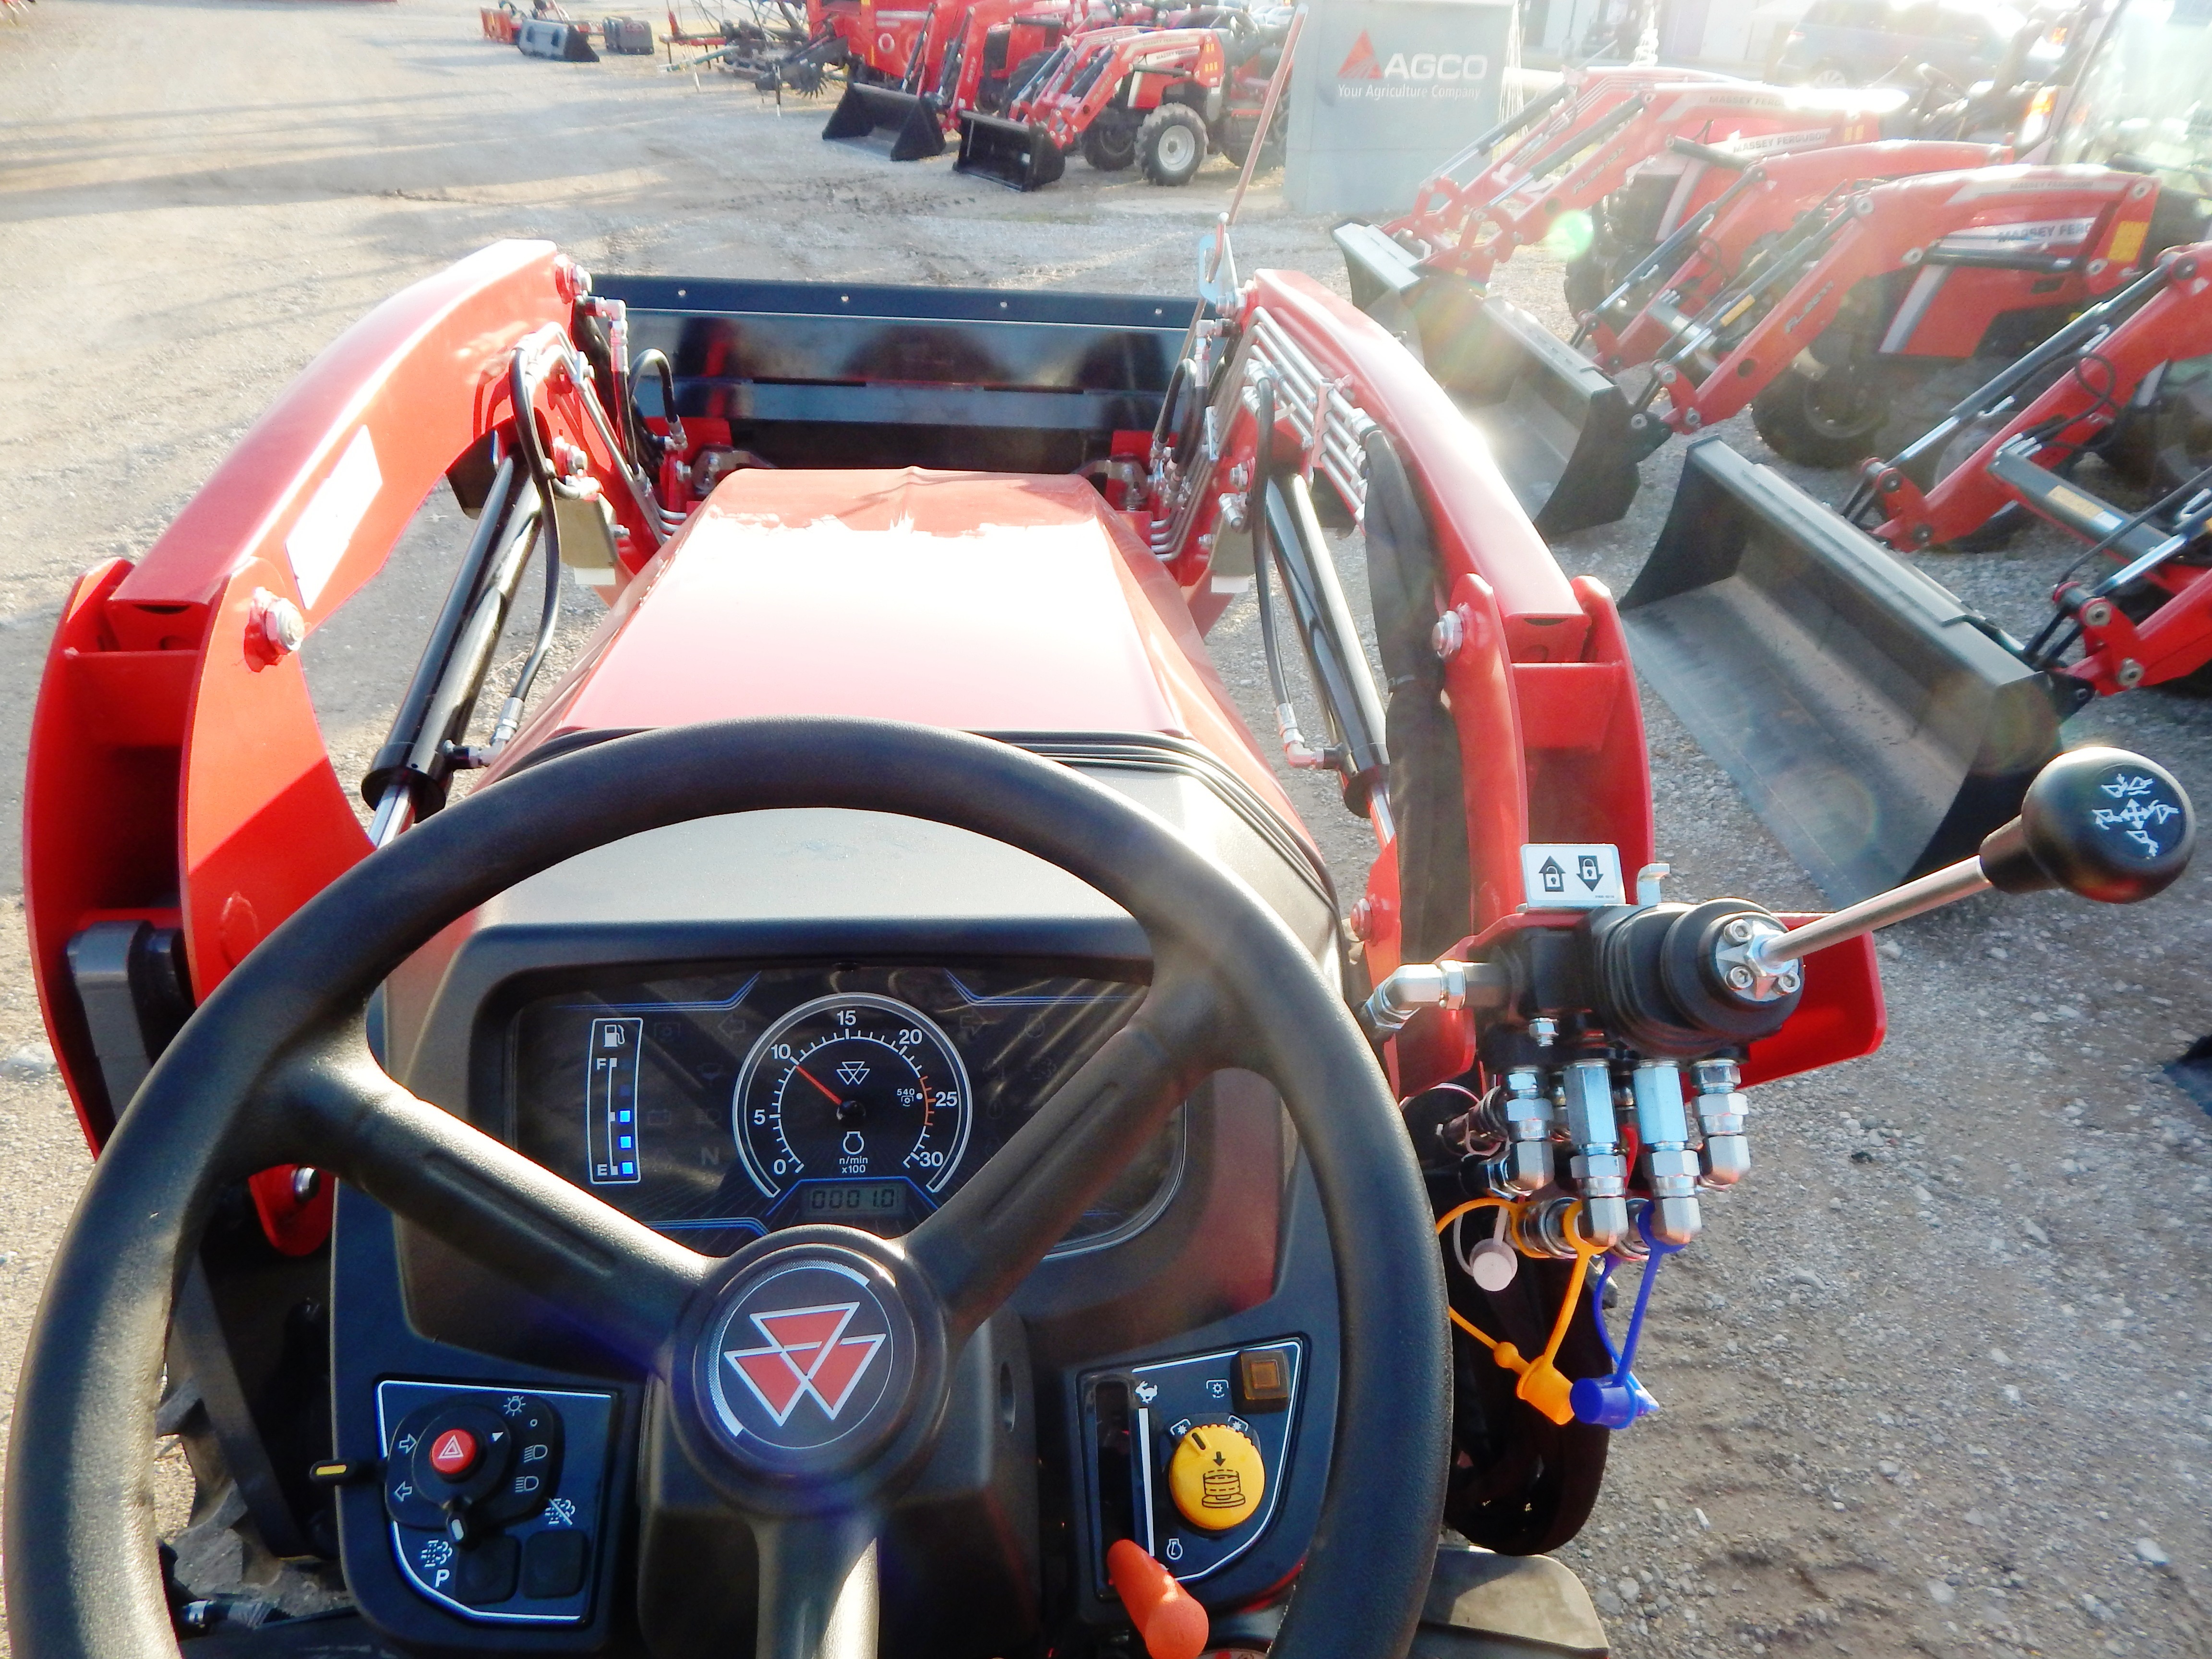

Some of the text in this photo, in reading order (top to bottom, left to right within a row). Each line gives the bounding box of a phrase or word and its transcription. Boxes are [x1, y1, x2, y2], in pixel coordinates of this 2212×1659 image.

[1384, 53, 1488, 79] AGCO
[1338, 83, 1481, 101] Your Agriculture Company
[1733, 138, 1774, 153] MASSEY
[837, 1010, 856, 1026] 15
[899, 1029, 923, 1045] 20
[771, 1044, 791, 1059] 10
[597, 1058, 607, 1070] F
[897, 1088, 915, 1096] 540
[935, 1091, 958, 1106] 25
[754, 1109, 766, 1125] 5
[773, 1159, 786, 1175] 0
[839, 1155, 868, 1165] n/min
[920, 1152, 944, 1167] 30
[597, 1164, 608, 1176] E
[842, 1164, 866, 1174] x100
[434, 1568, 450, 1587] P
